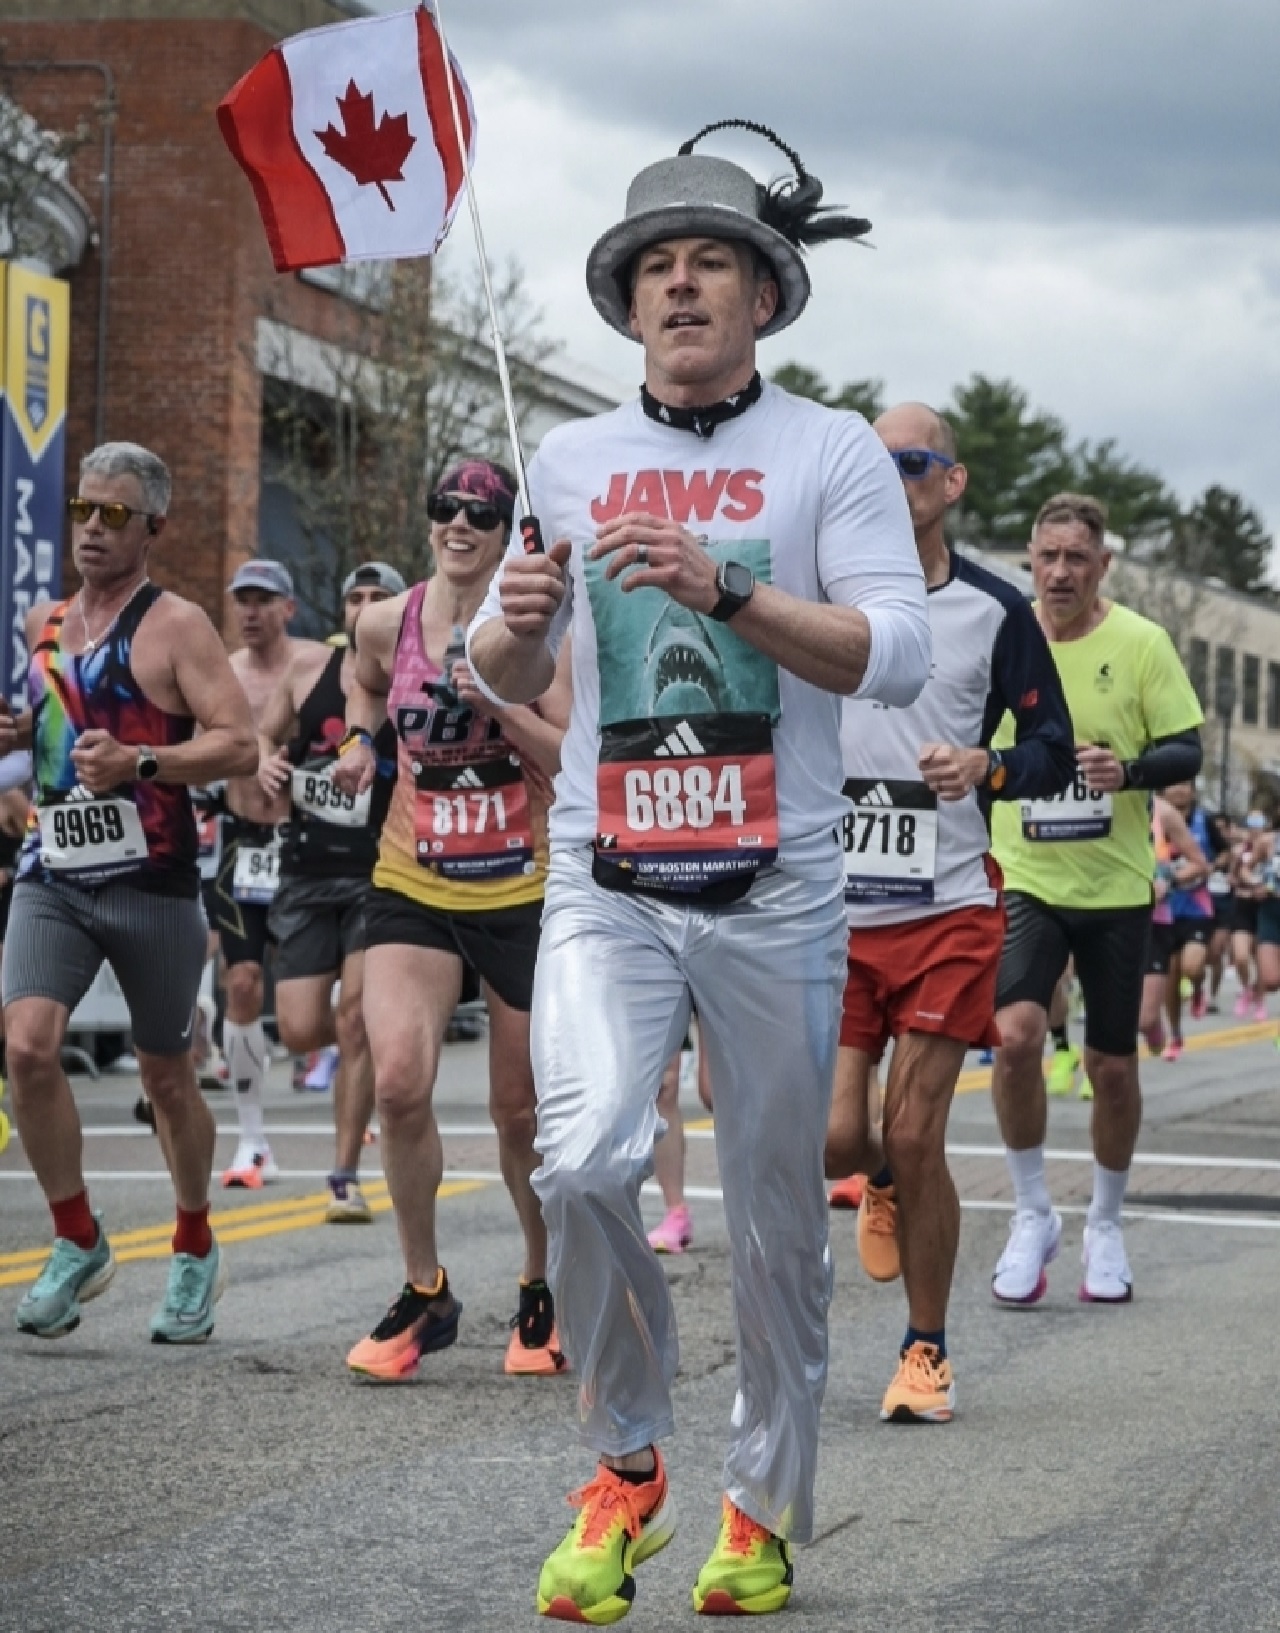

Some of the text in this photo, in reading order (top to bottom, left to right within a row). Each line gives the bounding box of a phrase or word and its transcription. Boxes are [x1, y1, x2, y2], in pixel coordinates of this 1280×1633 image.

[590, 469, 765, 525] JAWS
[432, 790, 506, 836] 8171
[624, 764, 747, 831] 6884
[54, 804, 124, 849] 9969
[658, 861, 699, 873] BOSTON
